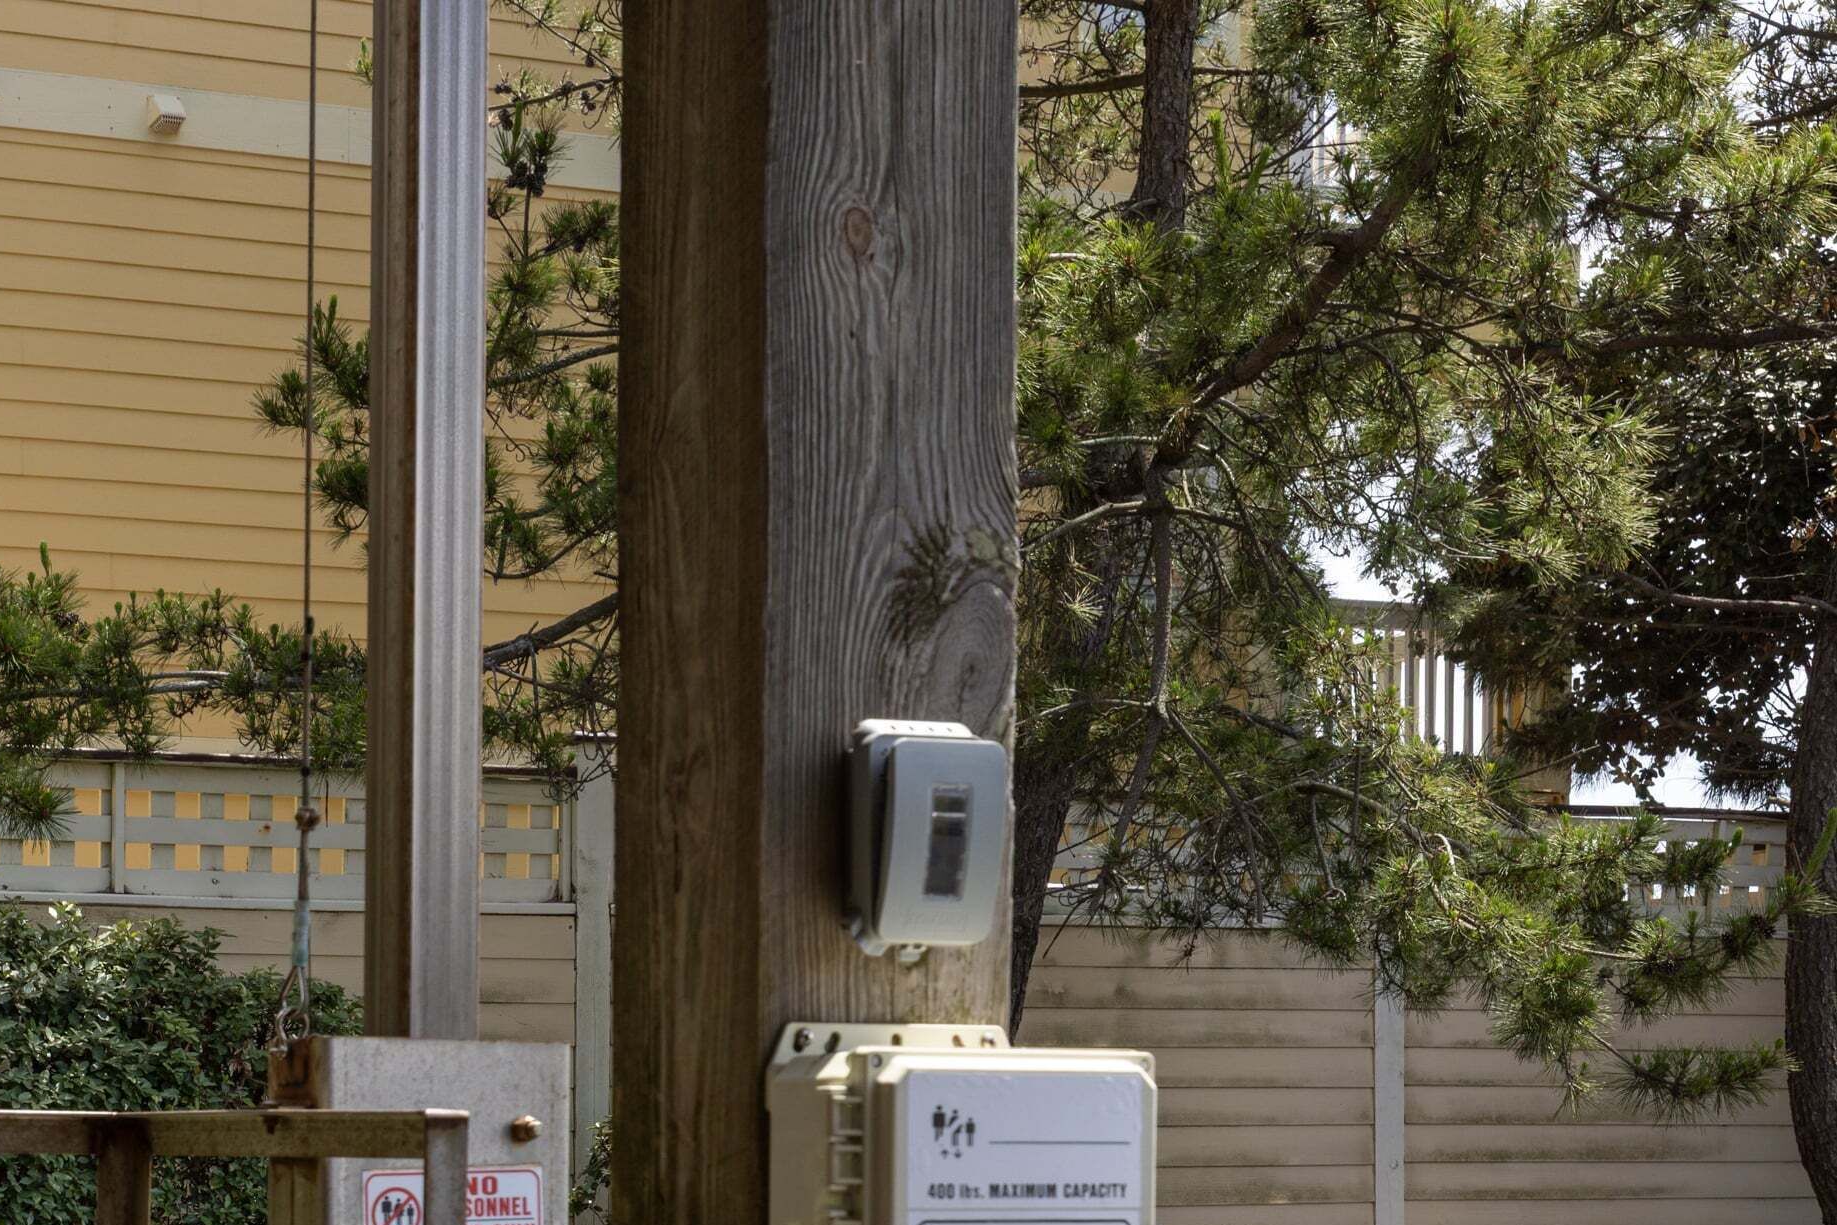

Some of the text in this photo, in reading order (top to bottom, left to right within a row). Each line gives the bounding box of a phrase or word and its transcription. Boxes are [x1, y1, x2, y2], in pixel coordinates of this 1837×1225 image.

[466, 1175, 498, 1195] NO
[928, 1182, 1127, 1199] 400 lbs. MAXIMUM CAPACITY
[465, 1196, 532, 1218] SONNEL
